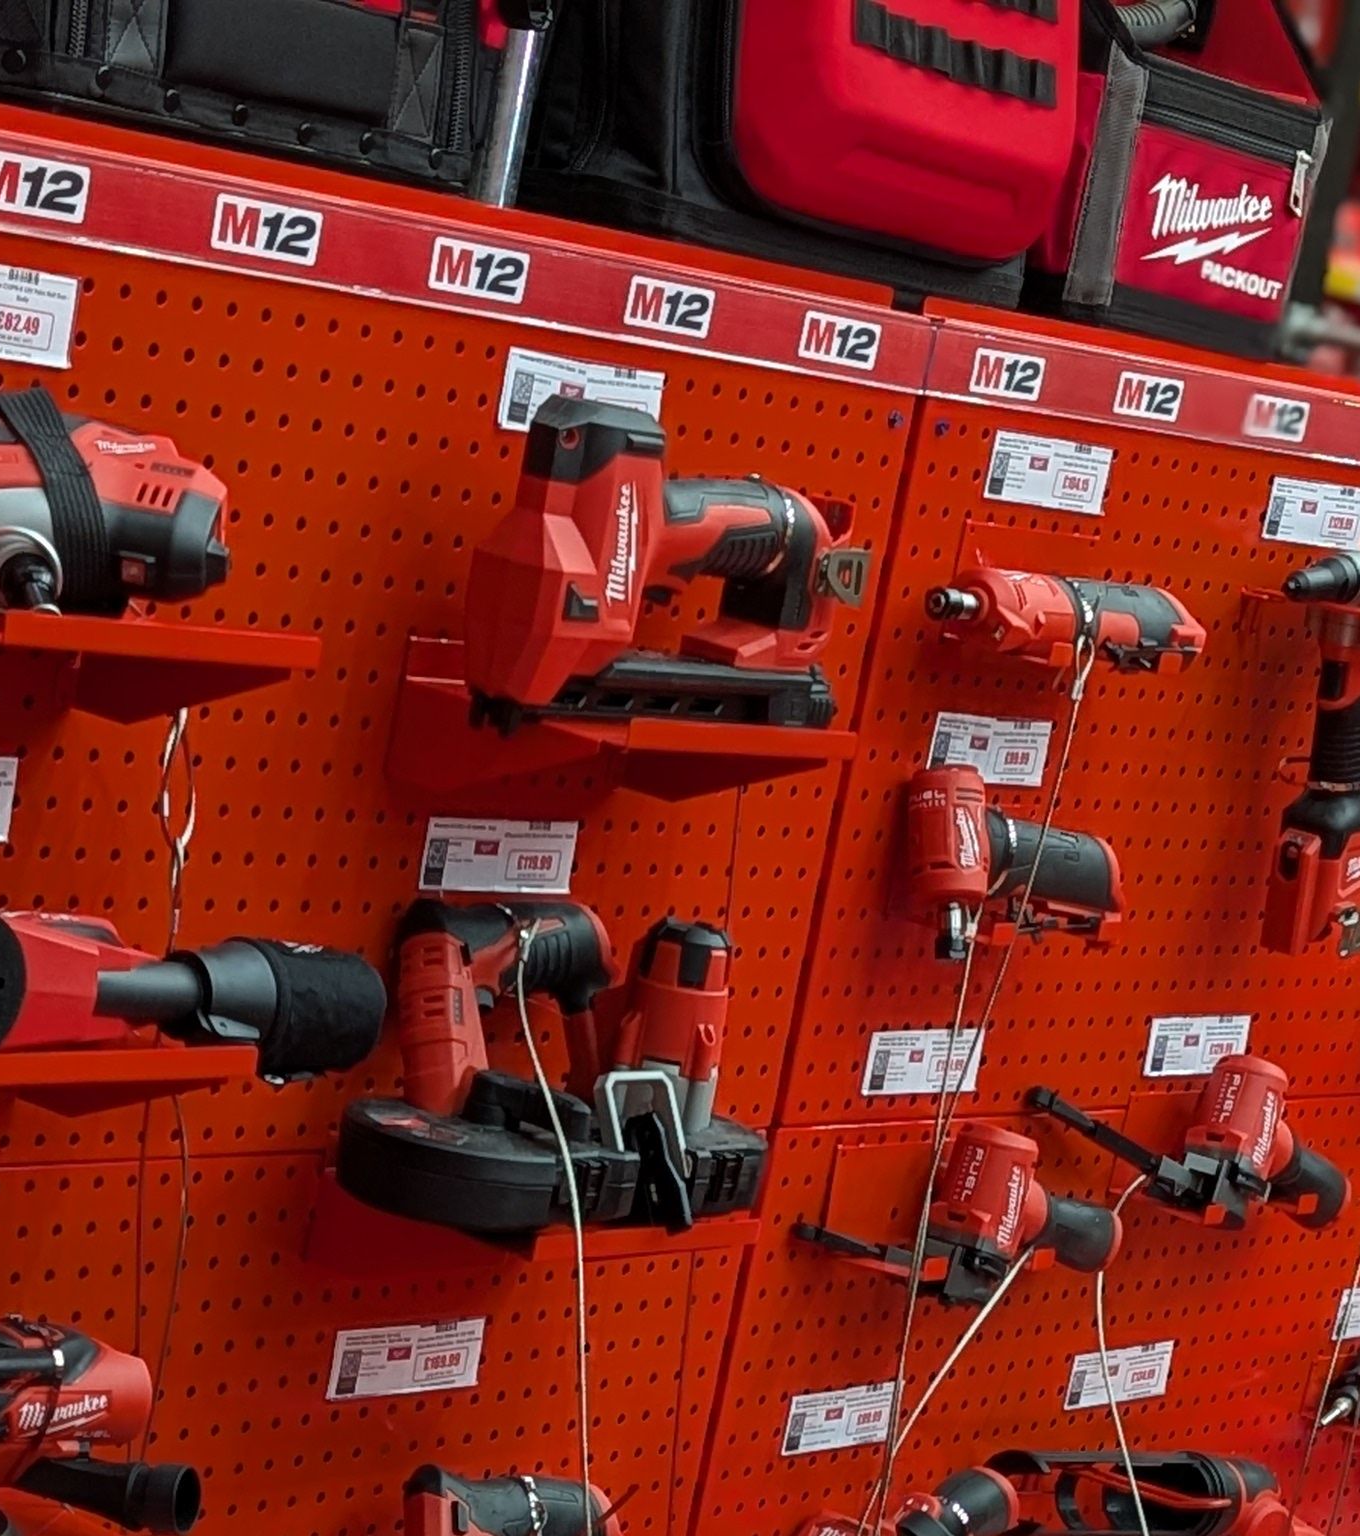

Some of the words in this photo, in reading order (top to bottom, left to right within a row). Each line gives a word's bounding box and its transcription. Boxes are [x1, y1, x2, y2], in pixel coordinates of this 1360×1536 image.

[218, 204, 319, 257] M12
[1149, 172, 1273, 239] Milwaukee
[437, 243, 524, 298] M12
[1201, 260, 1283, 301] PACKOUT
[629, 283, 710, 332] M12
[804, 319, 876, 365] M12
[973, 355, 1041, 396] M12
[1116, 378, 1179, 418] M12
[1253, 399, 1305, 438] M12
[605, 482, 631, 607] Milwaukee
[955, 806, 976, 867] Milwaukee
[1219, 1073, 1241, 1124] FUEL
[1250, 1091, 1274, 1168] Milwaukee
[961, 1146, 984, 1202] FUEL
[997, 1165, 1022, 1249] Milwaukee
[18, 1394, 108, 1431] Miwaukee
